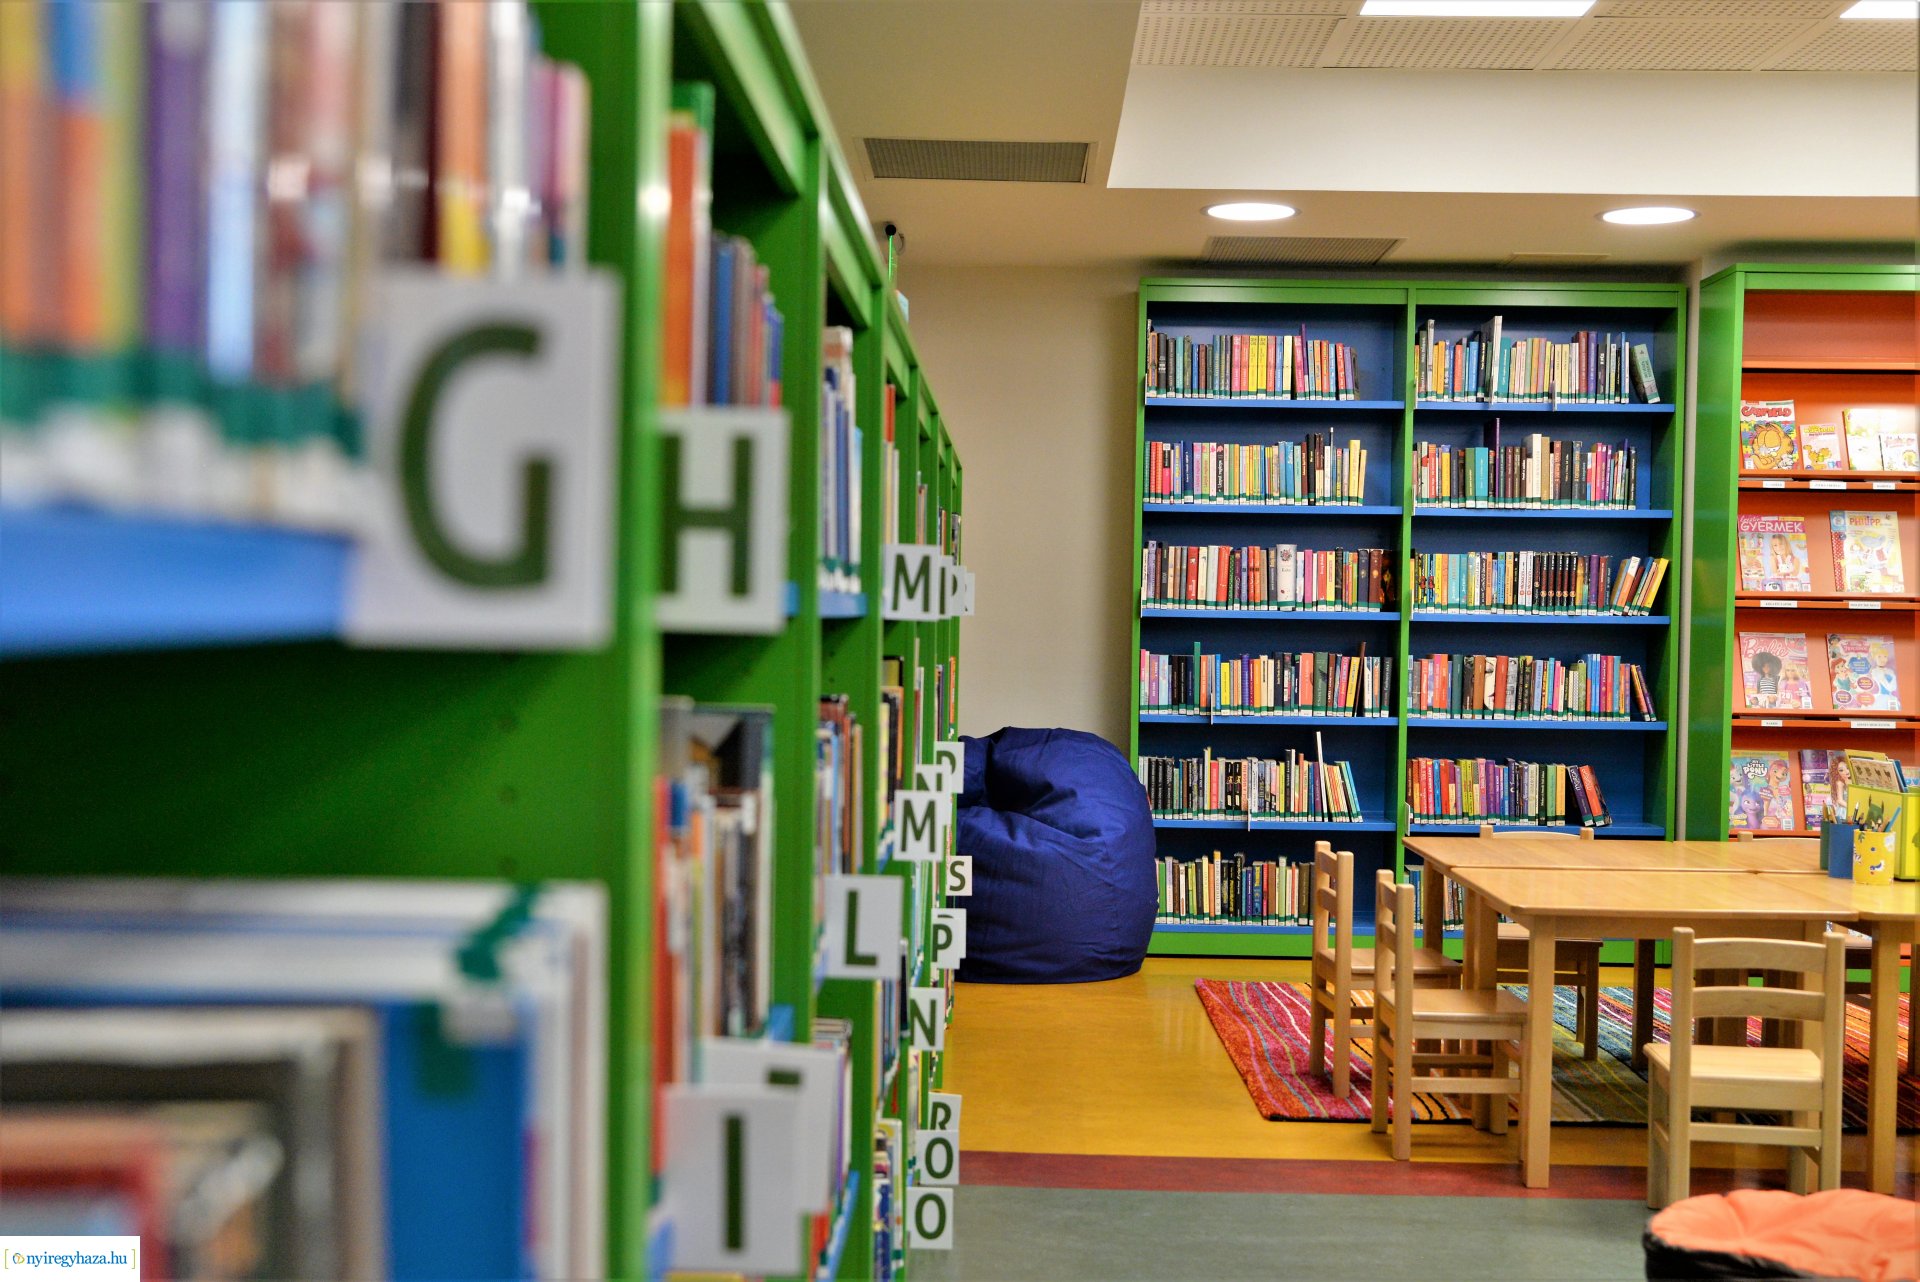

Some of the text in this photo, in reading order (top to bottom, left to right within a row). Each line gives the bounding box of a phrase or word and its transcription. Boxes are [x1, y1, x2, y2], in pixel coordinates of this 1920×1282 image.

[400, 320, 553, 591] G
[660, 434, 754, 596] H
[1740, 521, 1803, 532] GYERMEK
[891, 553, 931, 612] M
[1743, 637, 1789, 658] Barbie
[1743, 766, 1768, 779] PONY
[901, 799, 936, 853] M
[949, 860, 966, 892] S
[844, 889, 878, 967] L
[932, 924, 953, 962] P
[909, 998, 936, 1048] N
[930, 1101, 951, 1130] R
[925, 1137, 954, 1180] O
[915, 1193, 946, 1240] O
